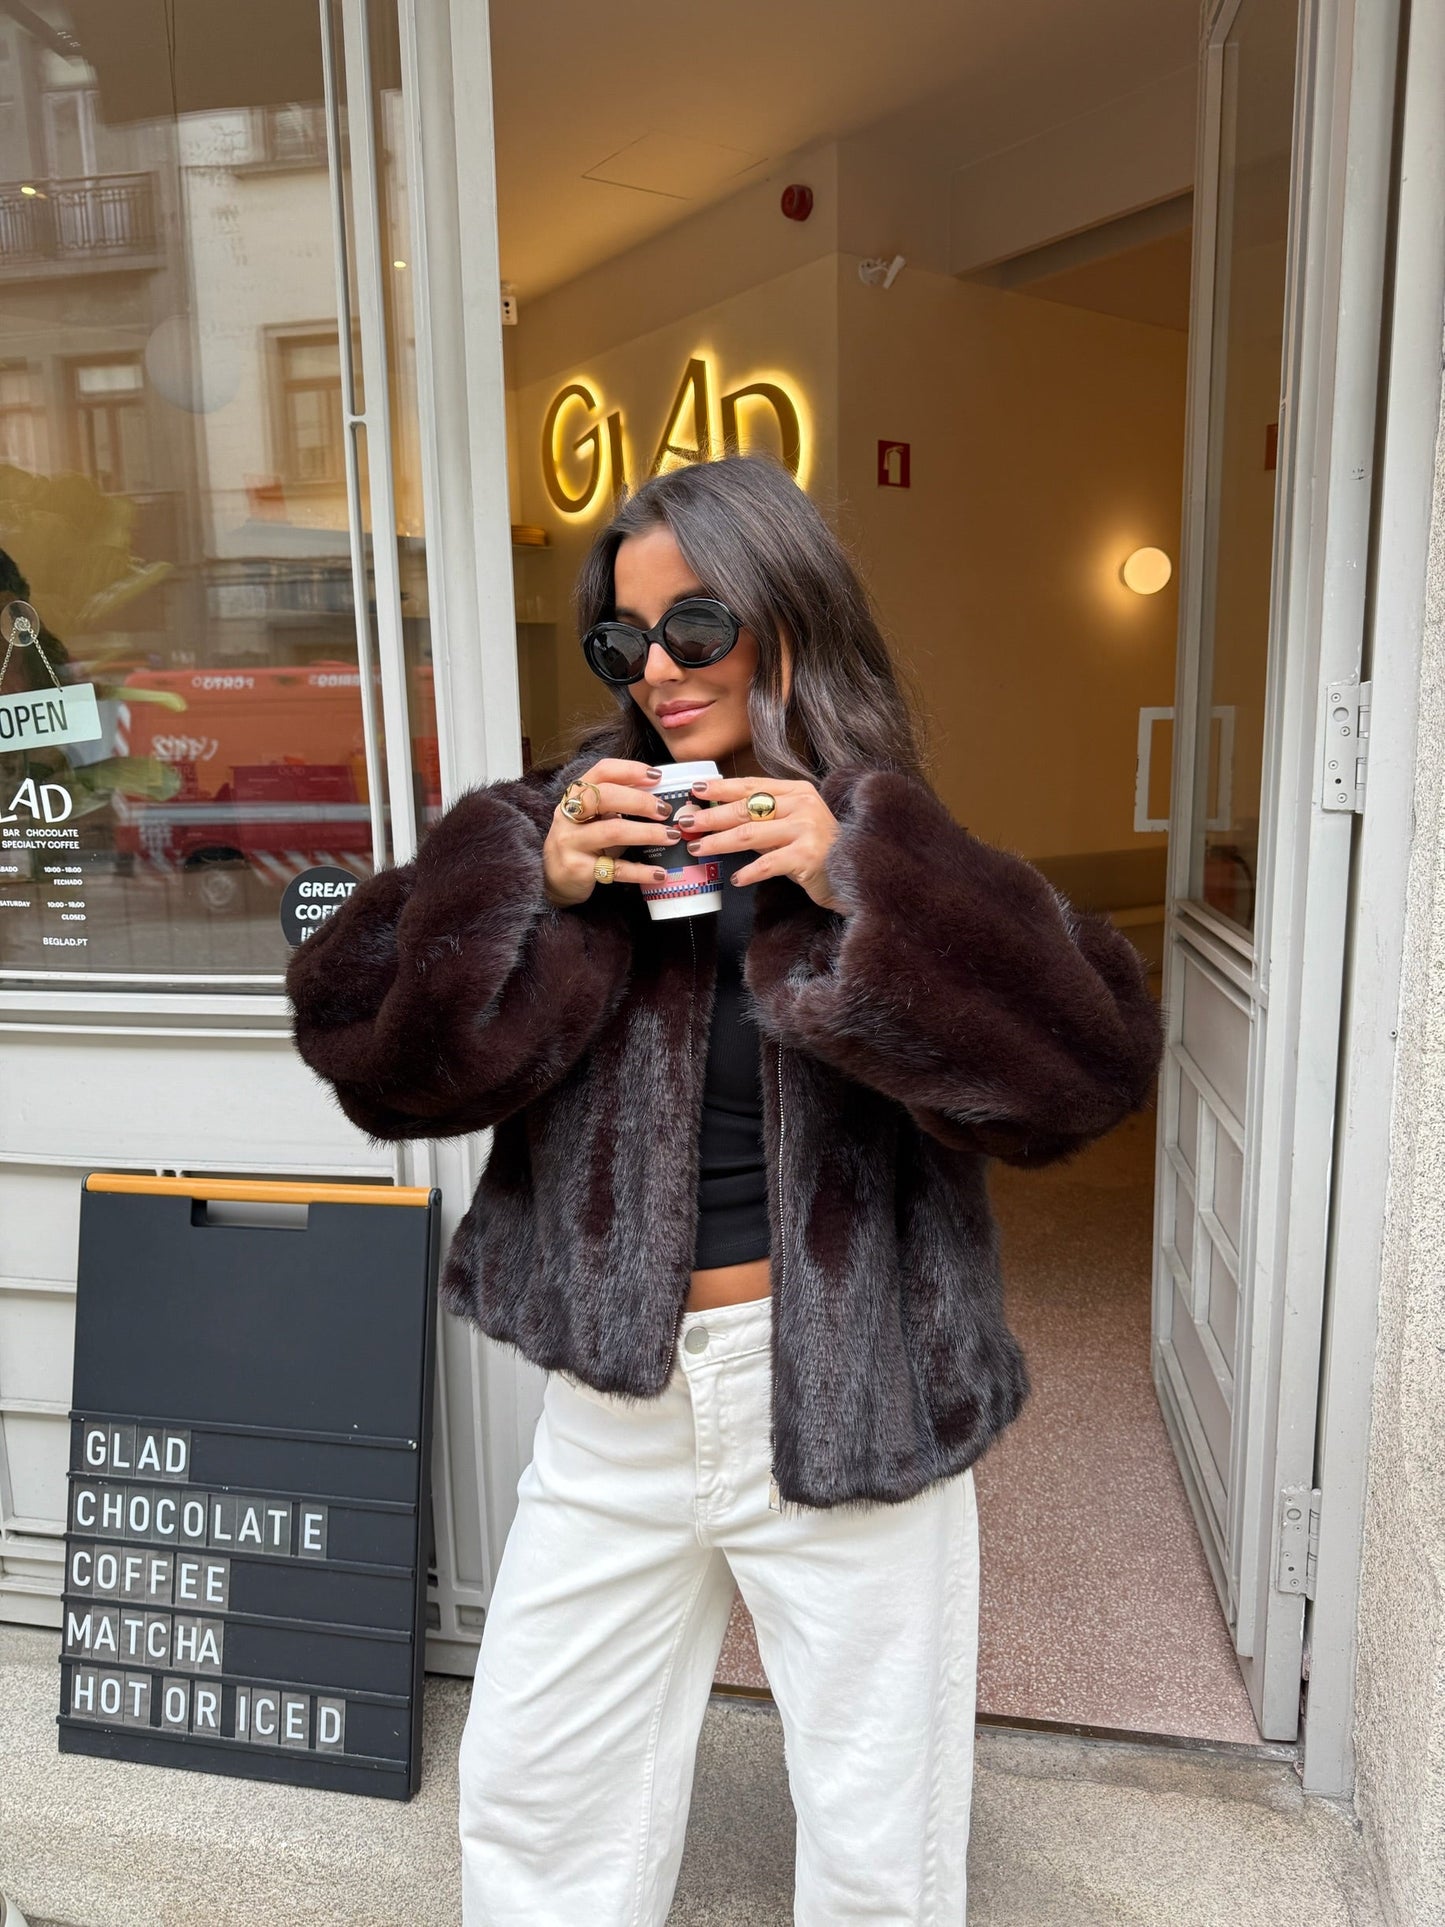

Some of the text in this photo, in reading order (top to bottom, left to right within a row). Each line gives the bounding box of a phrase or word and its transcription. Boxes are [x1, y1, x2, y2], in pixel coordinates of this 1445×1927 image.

[0, 700, 68, 739] OPEN
[1, 840, 80, 849] SPECIALTY COFFEE
[2, 828, 79, 837] BAR CHOCOLATE
[298, 881, 356, 898] GREAT
[61, 913, 86, 921] CLOSED
[42, 937, 88, 946] BEGLAD.PT
[85, 1430, 188, 1474] GLAD
[75, 1489, 323, 1551] CHOCOLATE
[72, 1550, 225, 1603] COFFEE
[66, 1611, 222, 1666] MATCHA
[74, 1674, 341, 1744] HOT OR ICED
